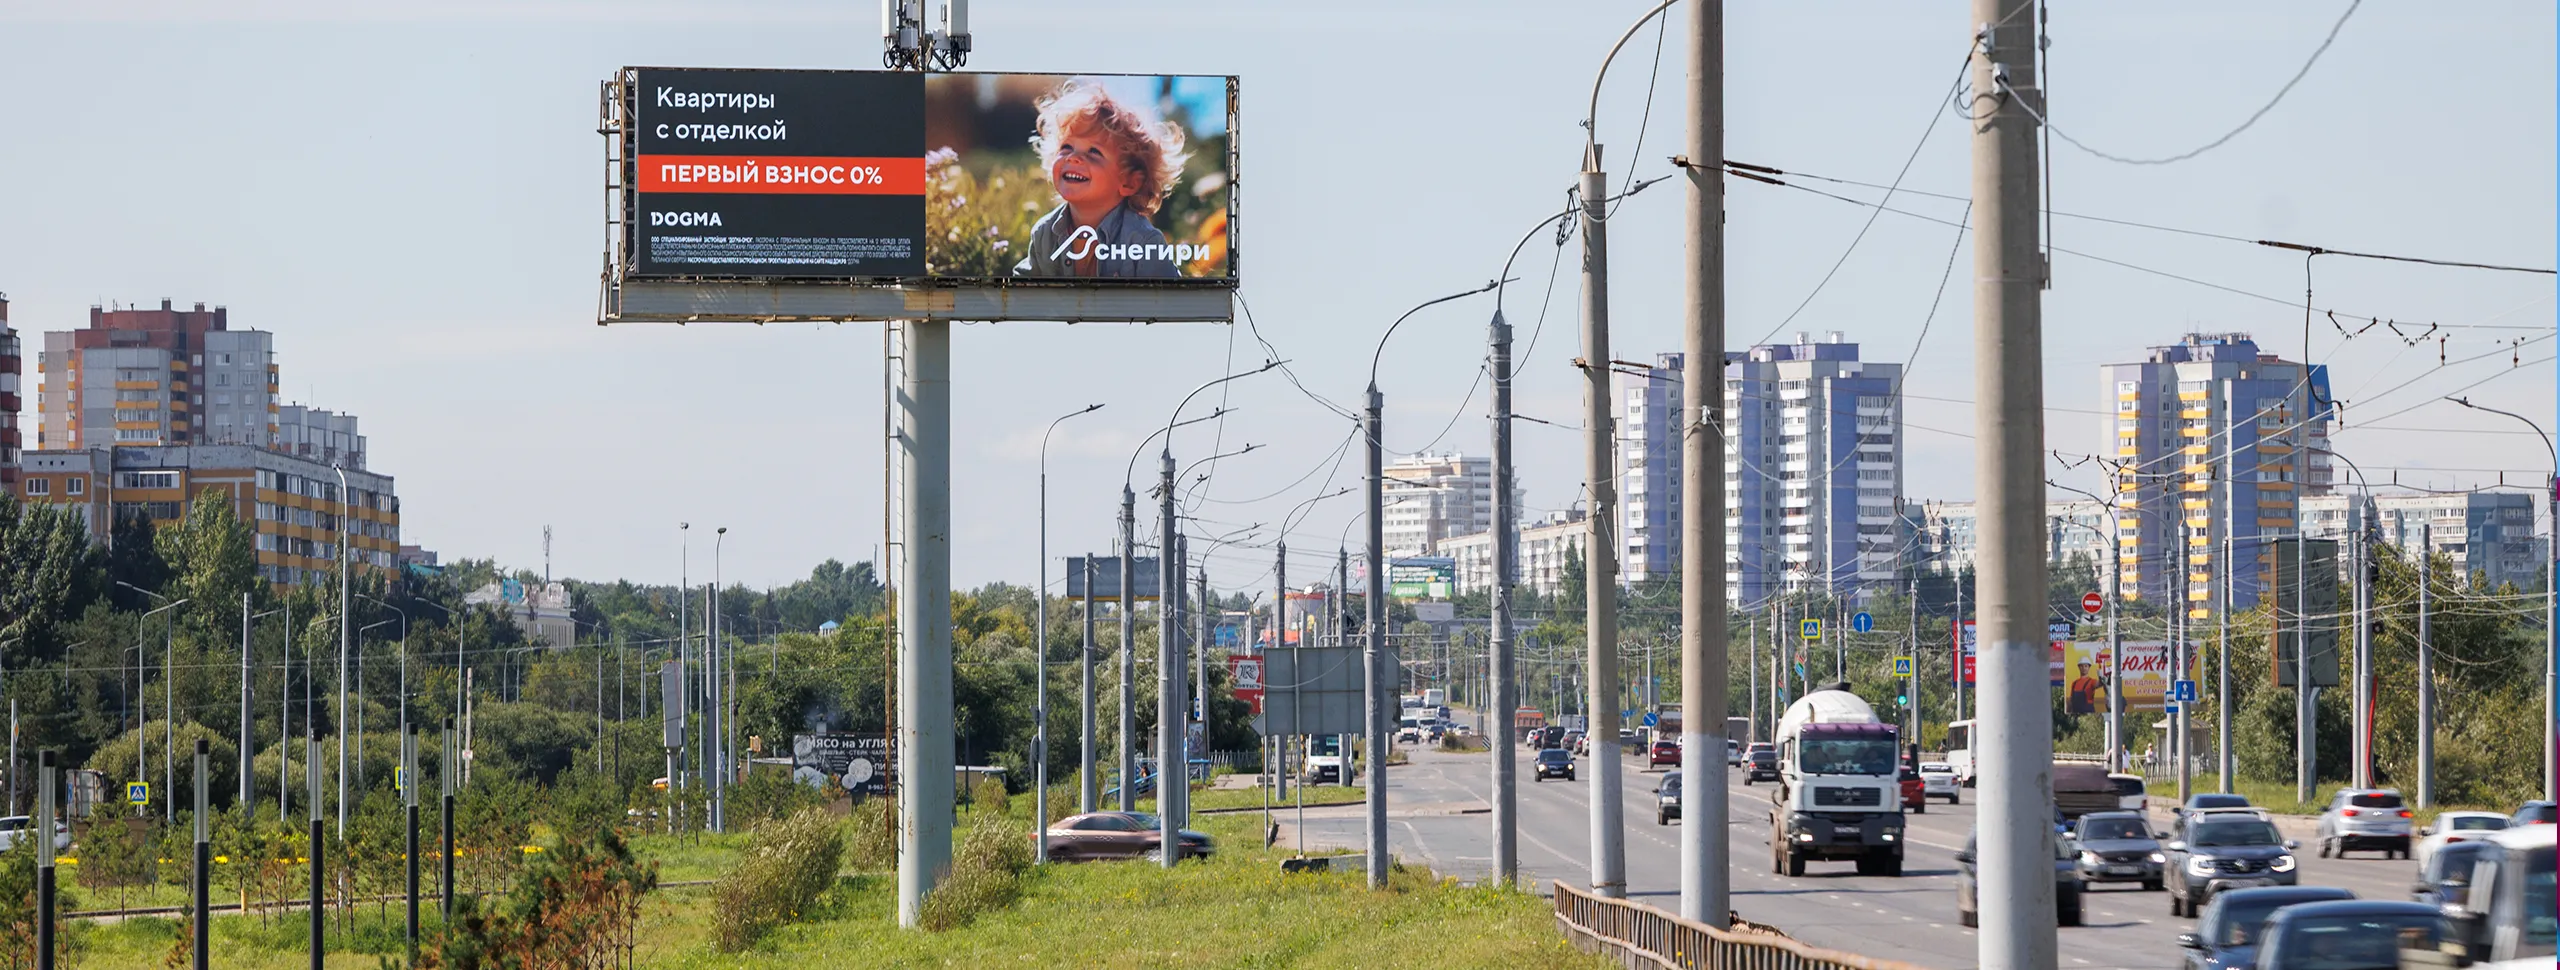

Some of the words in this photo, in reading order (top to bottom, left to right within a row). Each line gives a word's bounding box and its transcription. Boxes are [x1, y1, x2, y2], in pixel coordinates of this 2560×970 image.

[657, 86, 775, 113] Квартиры
[656, 123, 669, 139] с
[675, 119, 786, 142] отделкой
[661, 160, 759, 183] ПЕРВЫЙ
[765, 165, 845, 185] ВЗНОС
[850, 166, 883, 185] 0%
[650, 211, 723, 226] DOGMA
[1094, 243, 1210, 266] снегири
[806, 738, 839, 749] МЯСО
[842, 740, 856, 749] на
